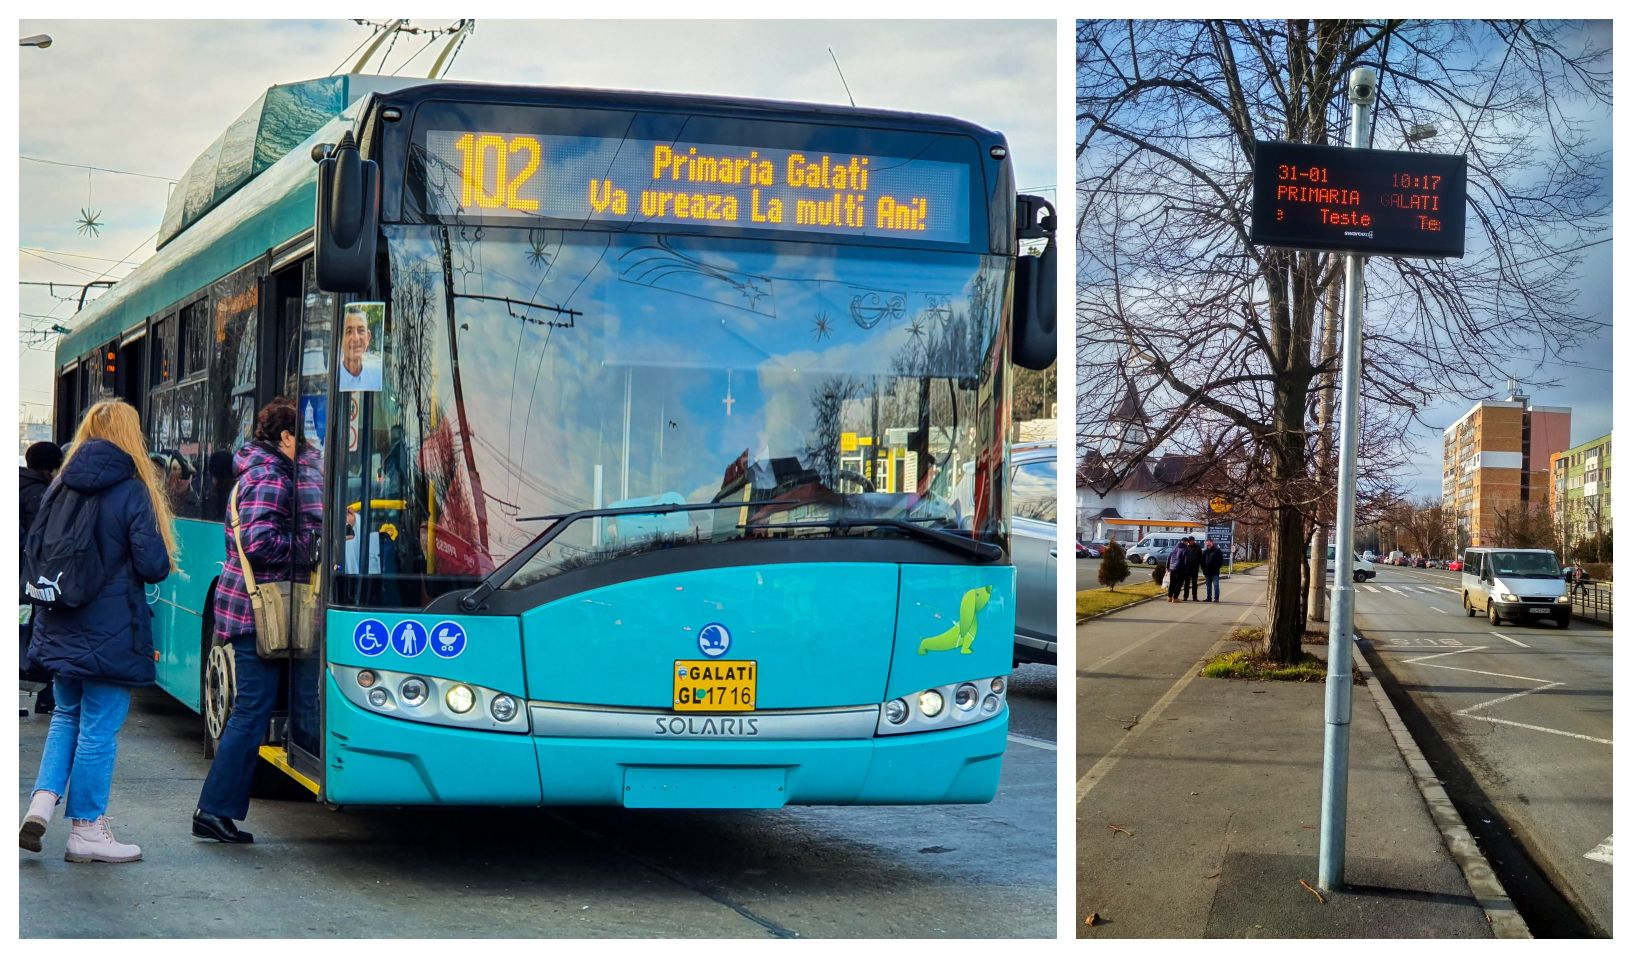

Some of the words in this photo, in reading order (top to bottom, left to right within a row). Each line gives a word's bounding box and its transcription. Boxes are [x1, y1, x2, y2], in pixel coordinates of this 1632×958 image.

[456, 134, 541, 211] 102
[653, 145, 773, 186] Primaria
[787, 153, 869, 191] Galati
[1279, 165, 1328, 183] 31-01
[1392, 173, 1441, 190] 10:17
[590, 179, 628, 216] Va
[641, 189, 738, 221] ureaza
[752, 188, 783, 223] La
[796, 193, 864, 227] multi
[876, 196, 927, 230] Ani!
[1277, 185, 1360, 205] PRIMARIA
[1380, 193, 1438, 211] GALATI
[1321, 208, 1371, 226] Teste
[1419, 215, 1441, 231] Te
[690, 666, 753, 680] GALATI
[678, 687, 702, 704] GL
[706, 687, 751, 705] 1716
[655, 717, 759, 735] SOLARIS
